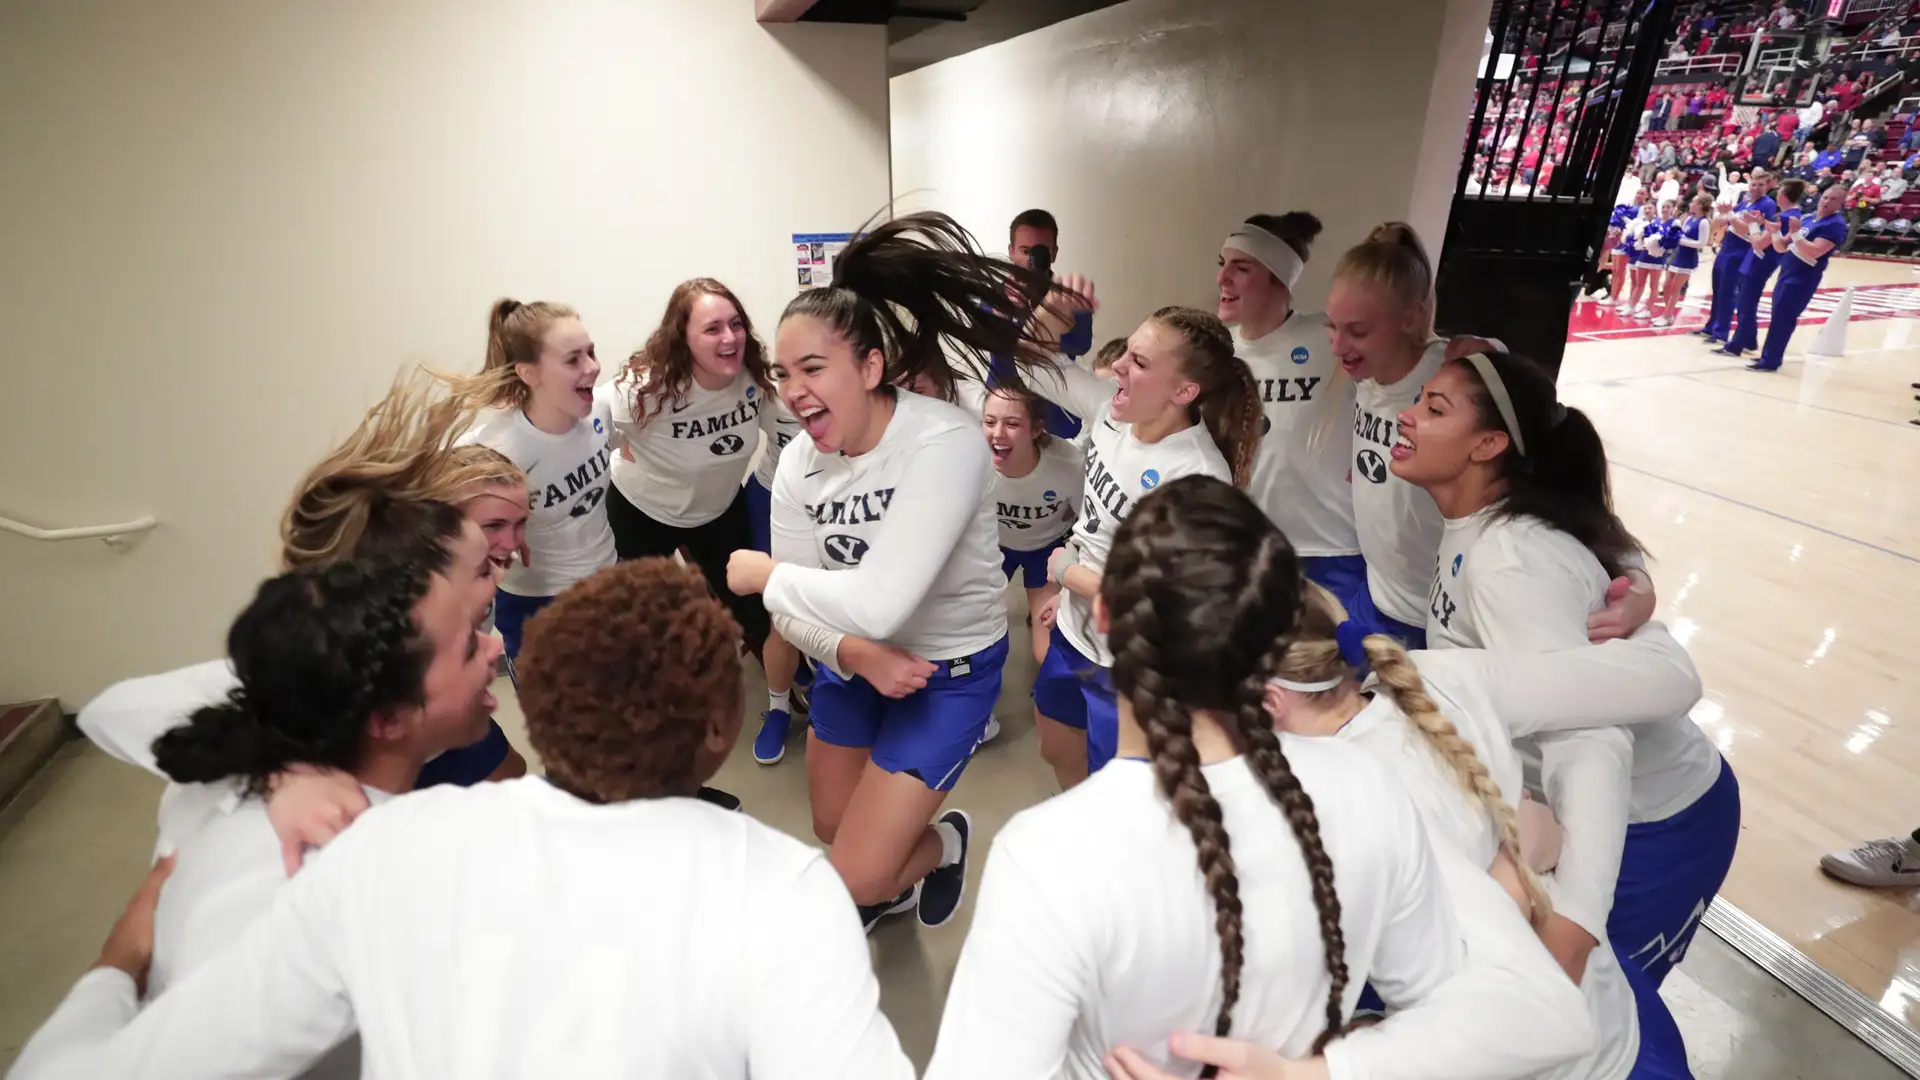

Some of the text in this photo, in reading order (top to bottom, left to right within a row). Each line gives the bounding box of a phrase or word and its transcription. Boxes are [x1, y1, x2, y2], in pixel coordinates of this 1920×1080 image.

[1258, 376, 1321, 402] ILY
[671, 399, 760, 439] FAMILY
[1086, 437, 1138, 523] AMIL
[953, 657, 966, 665] XL
